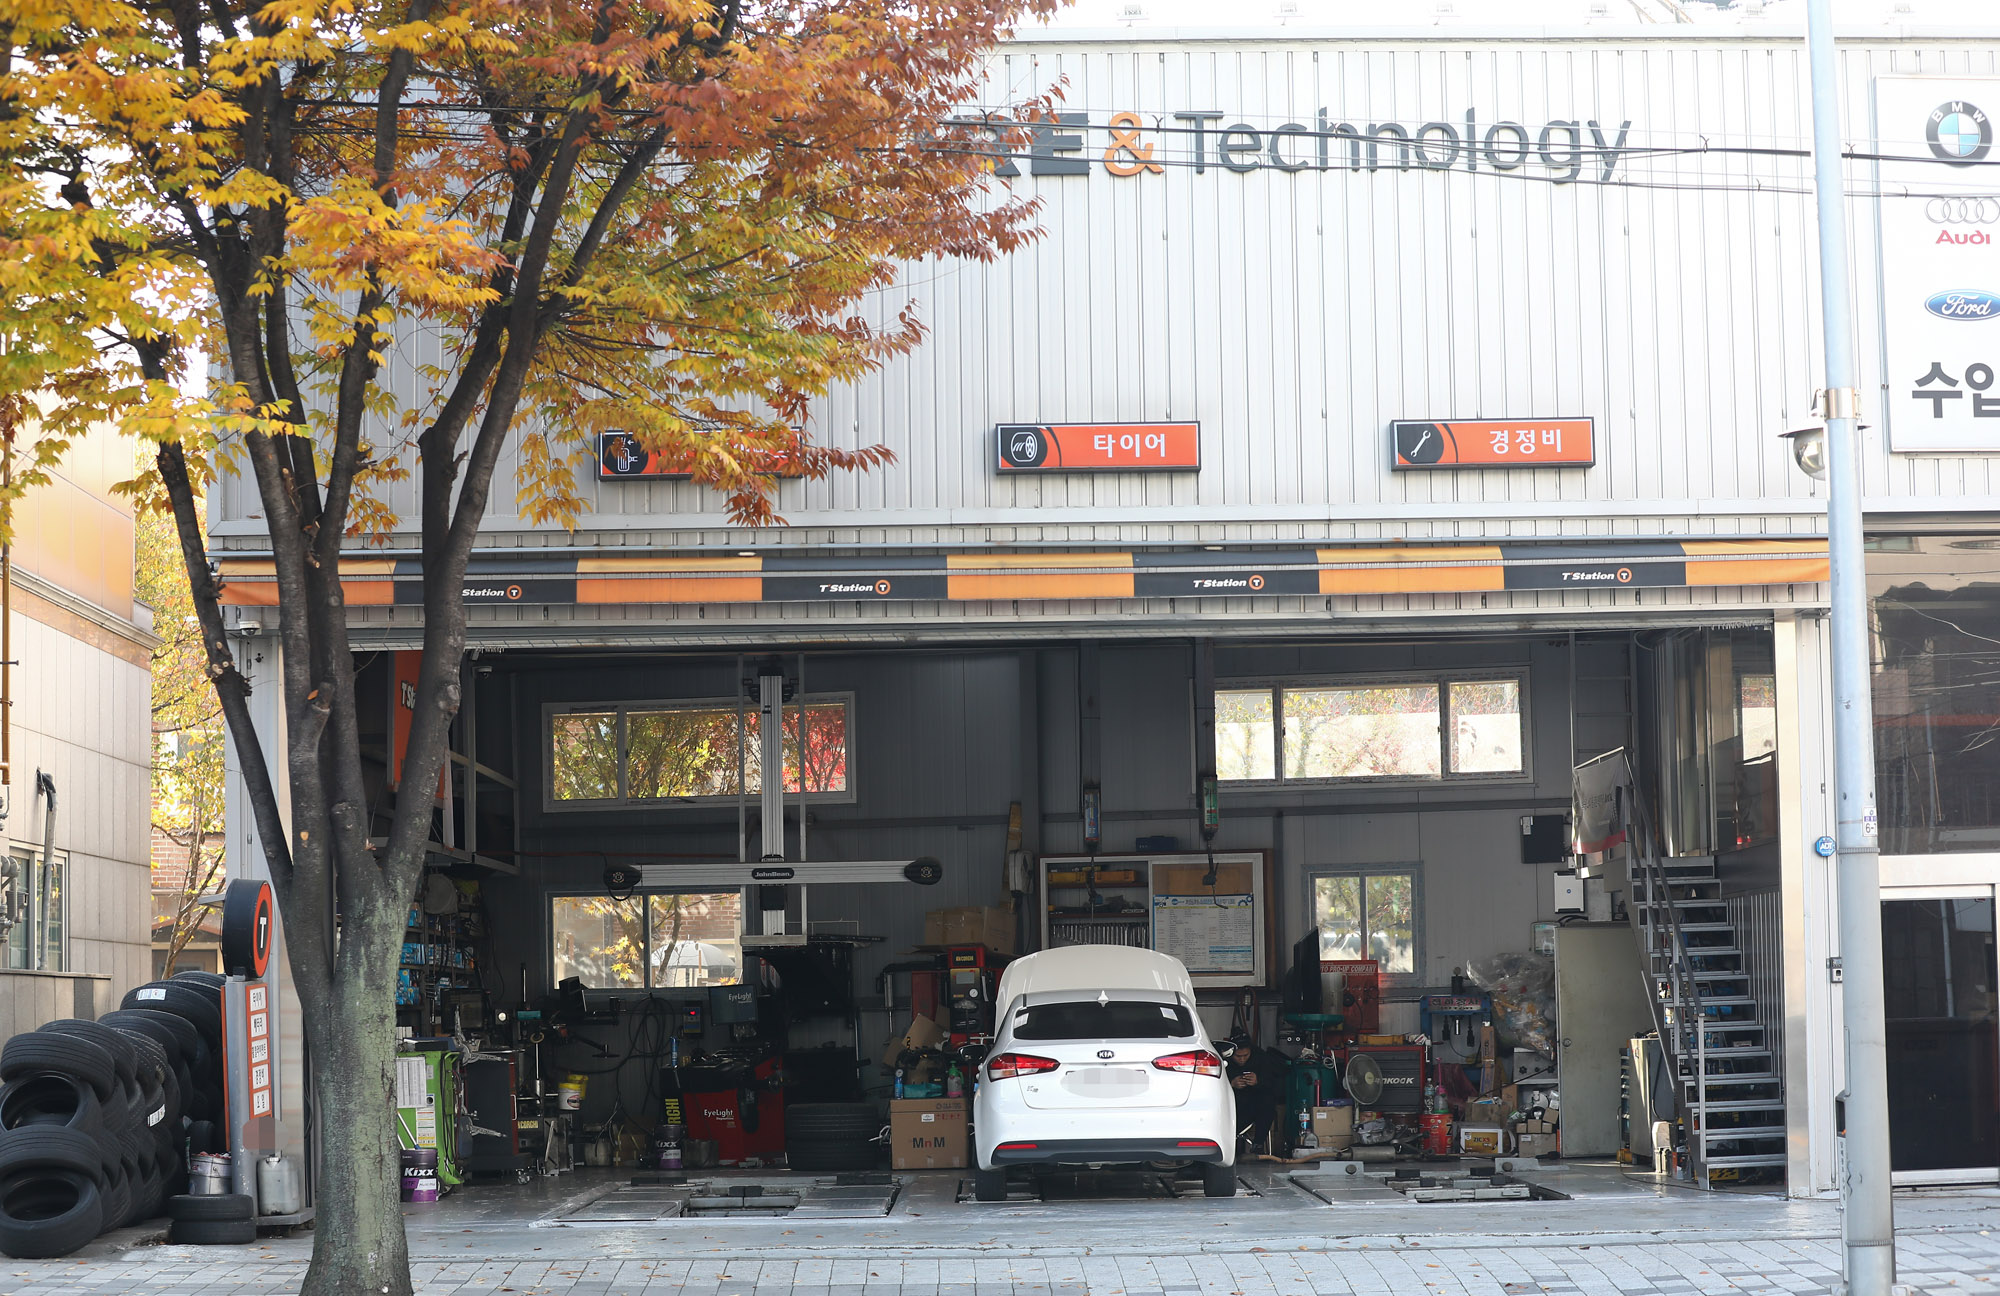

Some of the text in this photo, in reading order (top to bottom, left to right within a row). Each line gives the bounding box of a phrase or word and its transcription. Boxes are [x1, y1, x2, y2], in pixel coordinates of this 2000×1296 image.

[1931, 102, 1986, 123] BMW
[1103, 111, 1165, 177] &
[1174, 106, 1632, 185] Technology
[1935, 229, 1991, 245] Audi
[1941, 294, 1992, 315] Ford
[1093, 433, 1166, 458] 타이어
[1489, 428, 1562, 455] 경정비
[1820, 842, 1833, 850] ADT
[703, 1108, 734, 1118] EyeLight
[912, 1136, 945, 1149] MnM
[404, 1167, 434, 1177] Kixx
